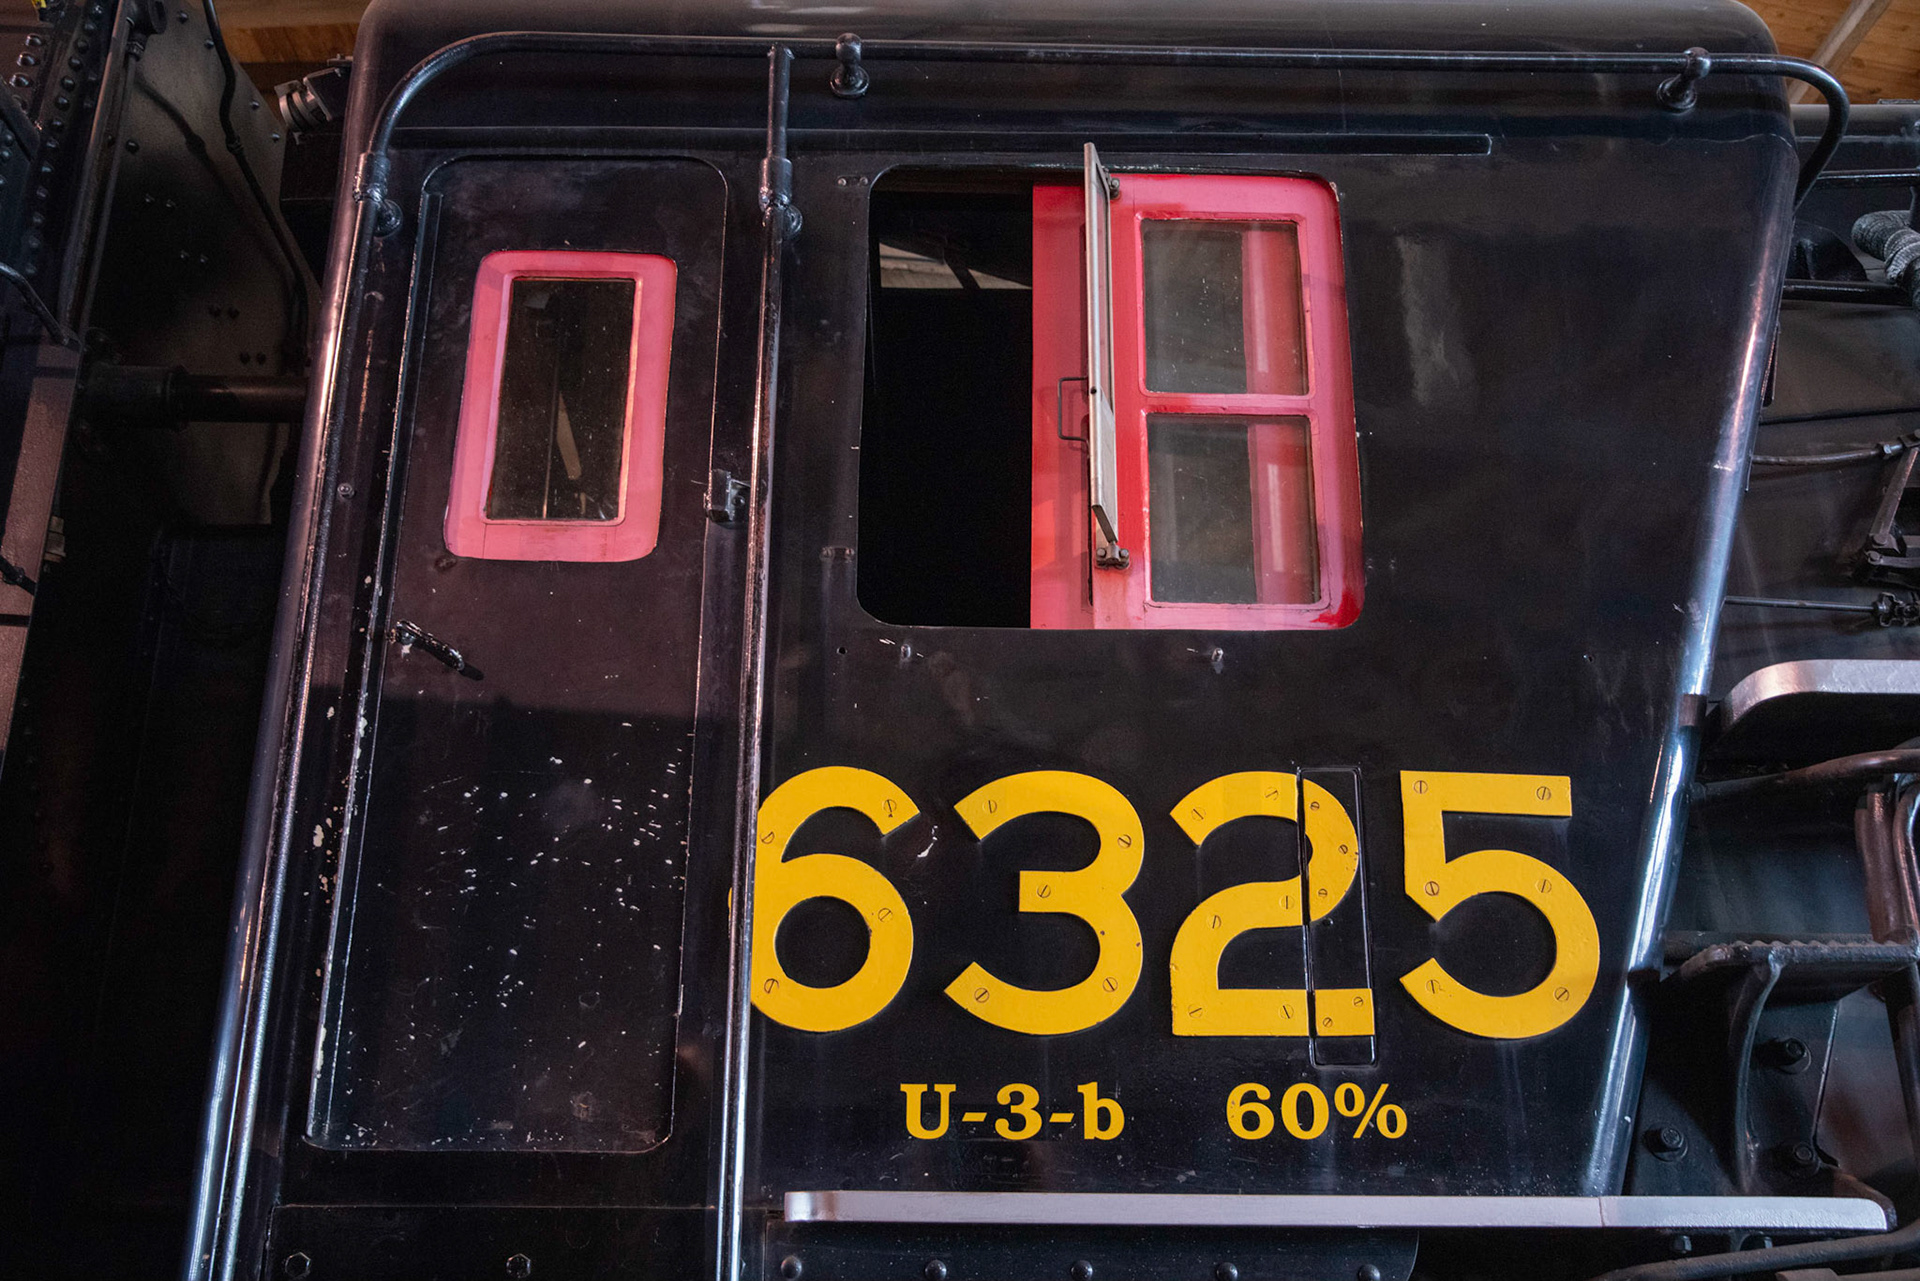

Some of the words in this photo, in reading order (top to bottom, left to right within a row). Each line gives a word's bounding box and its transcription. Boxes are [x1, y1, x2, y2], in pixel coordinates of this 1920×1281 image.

[730, 765, 1600, 1039] 6325
[899, 1081, 1126, 1142] U-3-b
[1225, 1081, 1409, 1141] 60%
